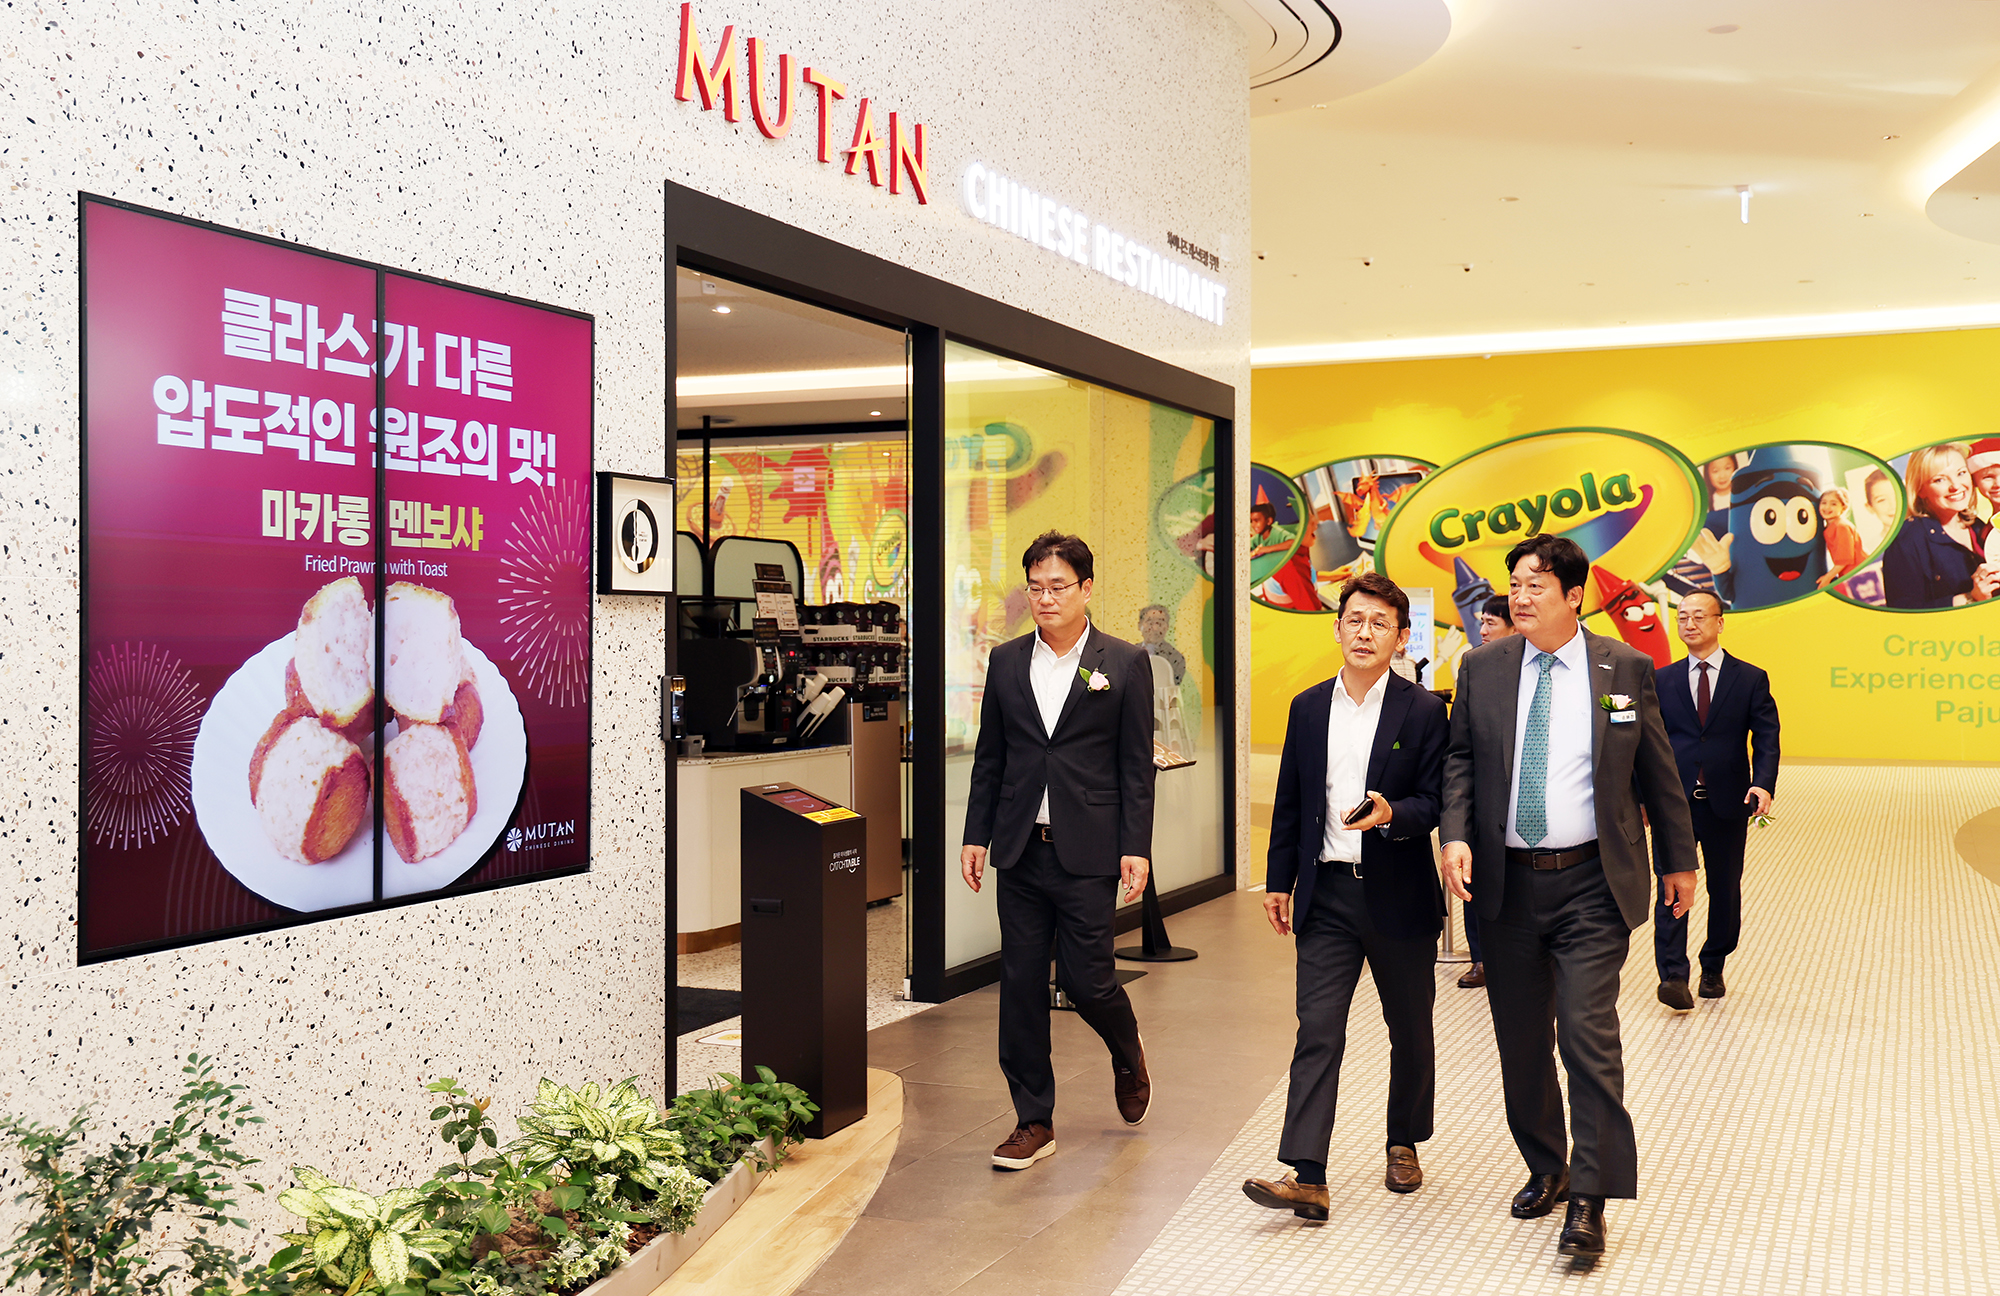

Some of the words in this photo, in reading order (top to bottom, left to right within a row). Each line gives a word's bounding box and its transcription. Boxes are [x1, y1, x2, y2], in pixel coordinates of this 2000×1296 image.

[674, 2, 928, 206] MUTAN
[963, 161, 1089, 266] CHINESE
[1091, 223, 1227, 326] RESTAURANT
[221, 287, 425, 387] 클라스가
[435, 331, 514, 402] 다른
[153, 374, 356, 467] 압도적인
[368, 406, 498, 481] 원조의
[509, 427, 556, 487] 맛!
[262, 488, 371, 547] 마카롱
[389, 499, 484, 552] 멘보샤
[1429, 471, 1637, 549] Crayola
[305, 554, 337, 573] Fried
[389, 558, 416, 575] with
[417, 559, 448, 577] Toast
[1883, 634, 2000, 662] Crayola
[1830, 666, 2000, 694] Experience
[1935, 700, 2000, 728] Paju
[524, 841, 551, 851] CHINESE
[553, 838, 575, 848] DINING
[525, 819, 575, 842] MUTAN
